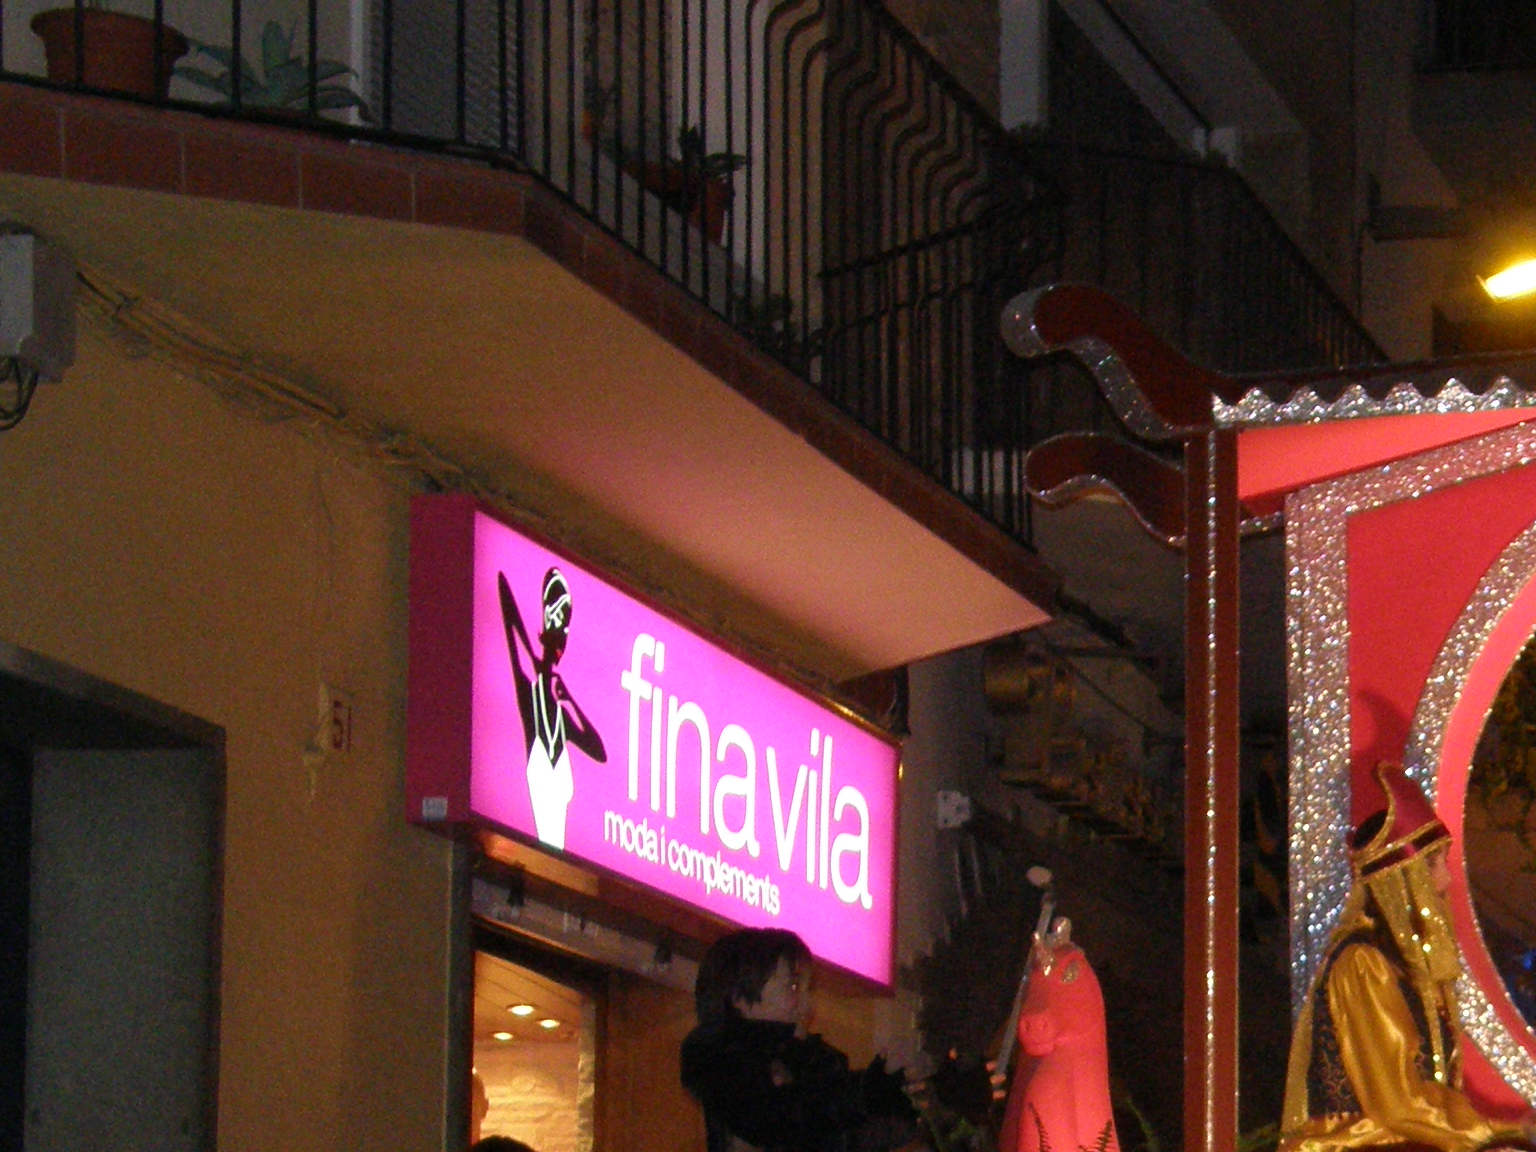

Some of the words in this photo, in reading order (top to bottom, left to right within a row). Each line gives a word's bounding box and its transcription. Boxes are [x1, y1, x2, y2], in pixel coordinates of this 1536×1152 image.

[604, 809, 659, 864] moda
[660, 825, 666, 865] i
[667, 838, 781, 916] complements
[620, 633, 873, 910] finavila
